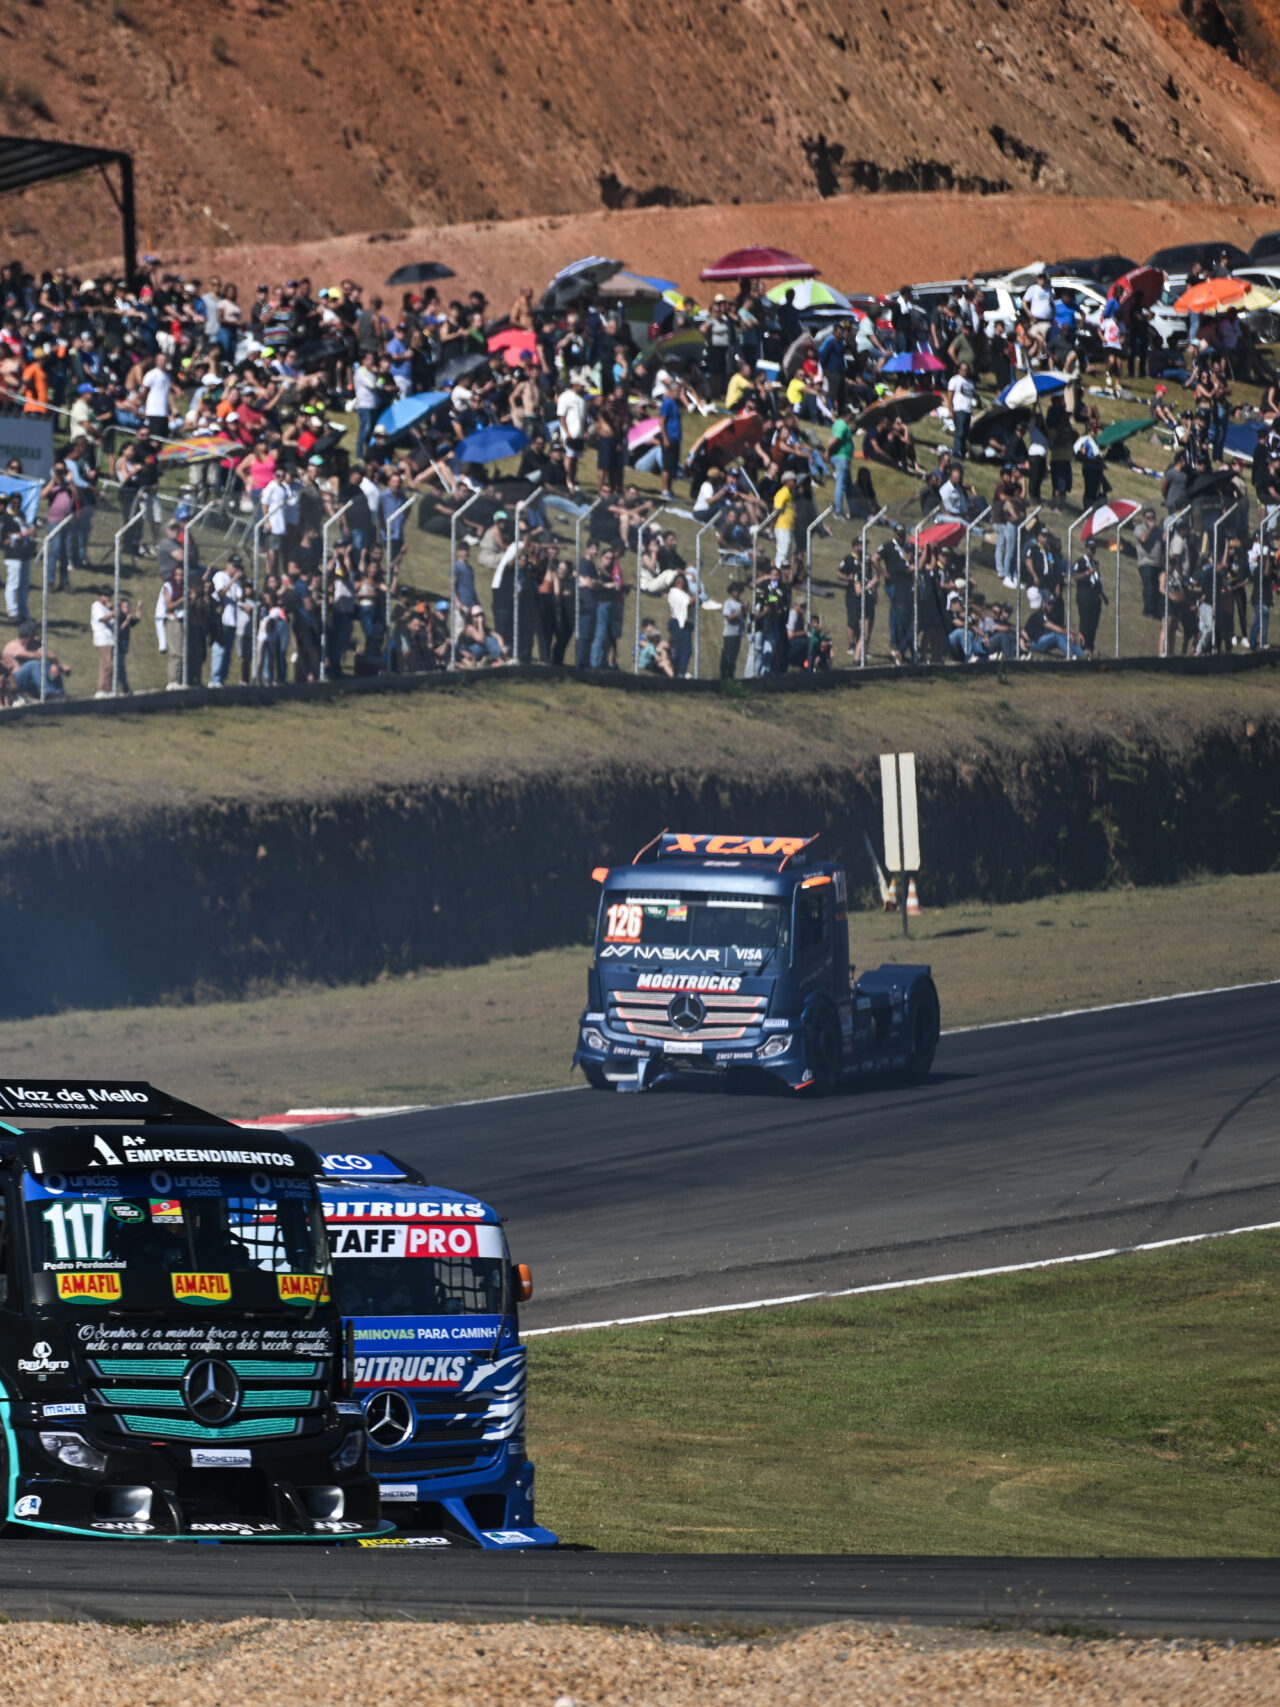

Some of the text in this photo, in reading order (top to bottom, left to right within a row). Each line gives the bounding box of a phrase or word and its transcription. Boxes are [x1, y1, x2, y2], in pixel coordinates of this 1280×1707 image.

[606, 904, 643, 938] 126
[735, 948, 763, 961] VISA
[637, 974, 742, 991] MOGITRUCKS
[6, 1086, 149, 1103] Vaz de Mello
[17, 1102, 99, 1110] CONSTRUTORA
[122, 1135, 147, 1147] A+
[125, 1149, 296, 1168] EMPREENDIMENTOS
[70, 1172, 120, 1188] unidas
[174, 1172, 221, 1188] unidas
[186, 1188, 222, 1197] pesados
[43, 1201, 104, 1259] 117
[409, 1228, 472, 1254] PRO
[43, 1261, 127, 1271] Pedro Perdoncini
[61, 1274, 119, 1295] AMAFIL
[174, 1275, 229, 1295] AMAFIL
[78, 1324, 95, 1341] O
[152, 1330, 163, 1338] a
[165, 1327, 205, 1339] minha
[206, 1326, 238, 1341] força
[263, 1330, 289, 1339] meu
[352, 1328, 416, 1340] EMINOVAS
[417, 1328, 450, 1339] PARA
[85, 1339, 110, 1351] nele
[121, 1342, 146, 1351] meu
[236, 1338, 260, 1351] dele
[44, 1404, 84, 1415] MAHLE
[196, 1453, 249, 1464] PROMETEON
